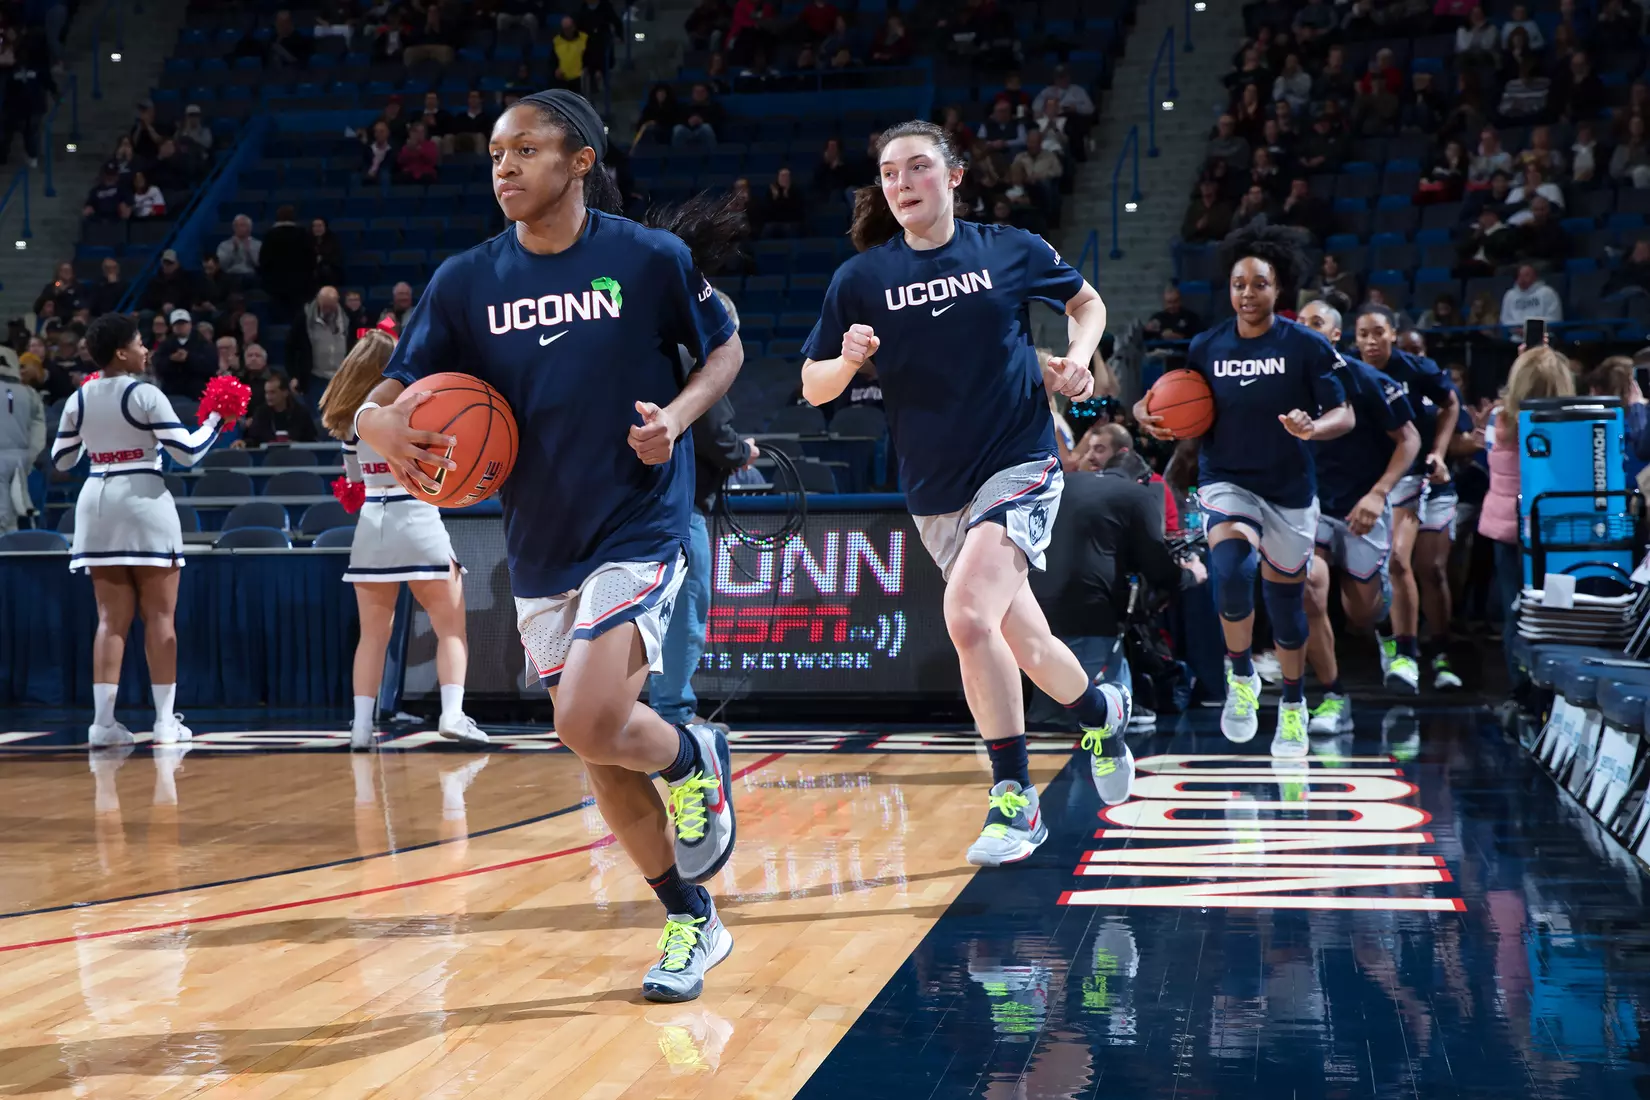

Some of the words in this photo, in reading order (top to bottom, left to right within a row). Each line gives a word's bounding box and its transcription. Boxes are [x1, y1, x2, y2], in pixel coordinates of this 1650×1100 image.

[885, 269, 993, 311] UCONN
[487, 290, 620, 335] UCONN
[1213, 357, 1286, 377] UCONN
[1593, 428, 1607, 507] POWERAE
[713, 529, 906, 597] ONN
[705, 605, 850, 643] ESPN
[741, 652, 873, 669] NETWORK
[1056, 754, 1468, 912] UCONN
